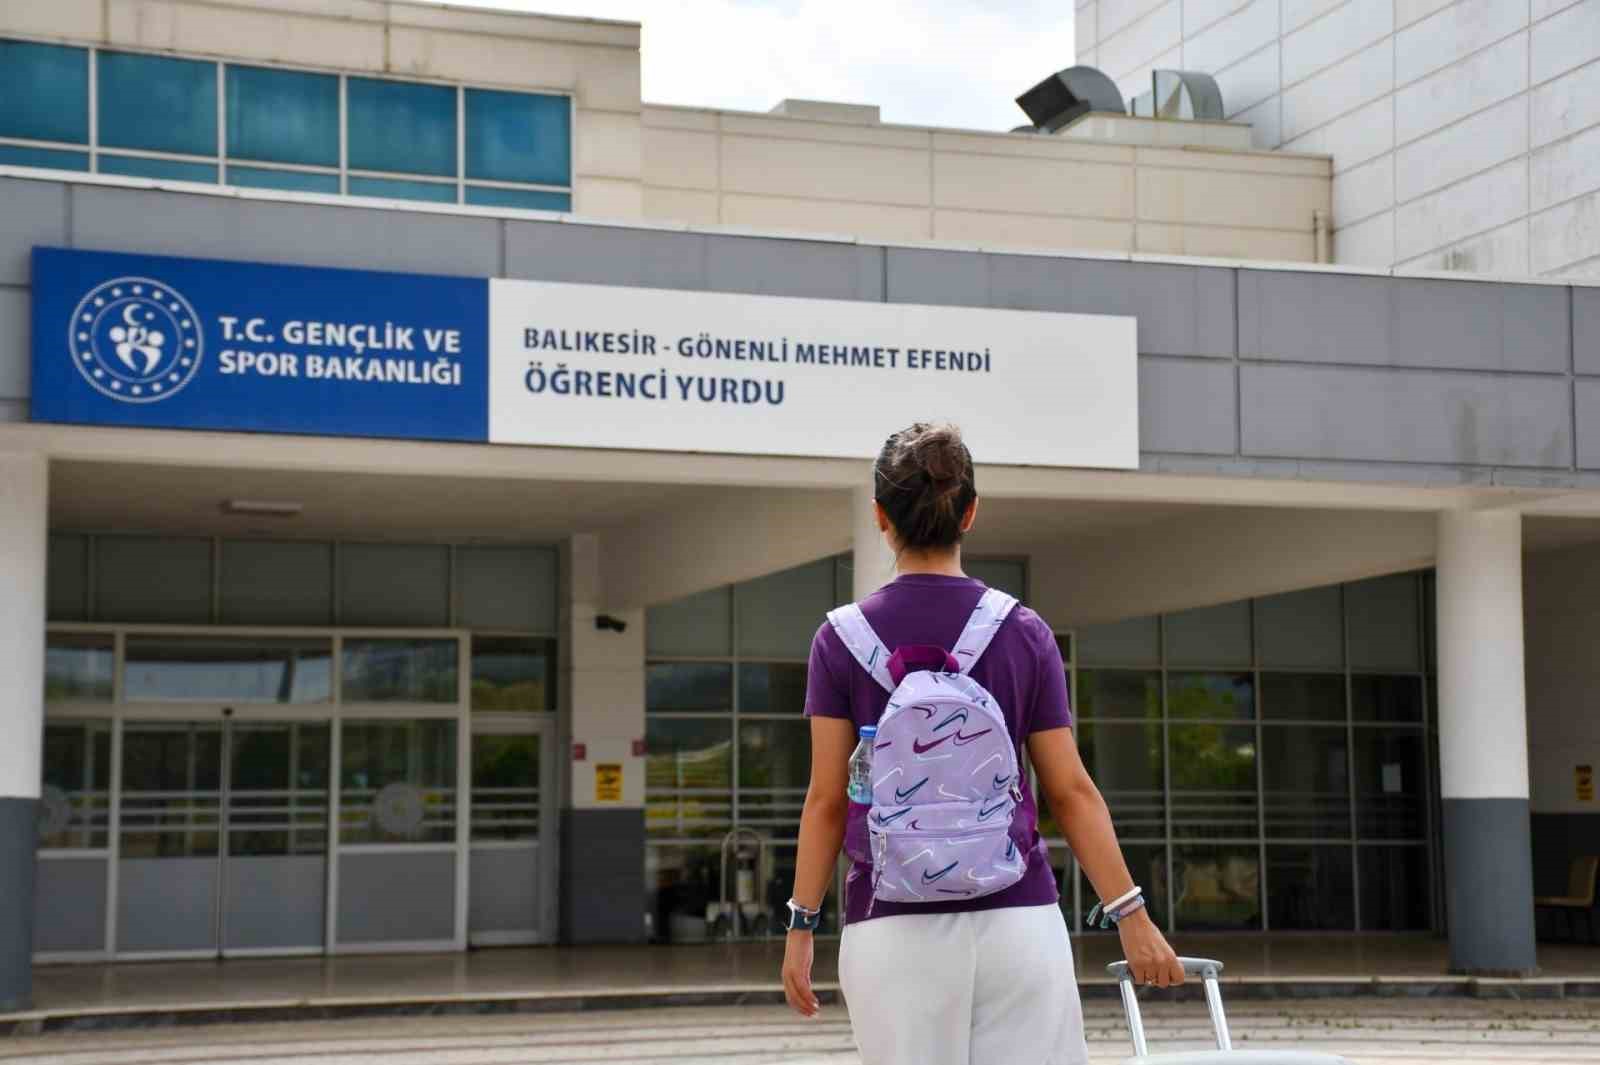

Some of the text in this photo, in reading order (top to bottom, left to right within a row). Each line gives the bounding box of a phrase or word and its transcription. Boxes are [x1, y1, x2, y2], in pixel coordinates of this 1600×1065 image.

[219, 317, 461, 354] T.C. GENÇLİK VE
[524, 327, 656, 356] BALIKESİR
[678, 334, 788, 363] GÖNENLİ
[795, 344, 899, 368] MEHMET
[906, 347, 991, 373] EFENDİ
[219, 350, 461, 385] SPOR BAKANLIĞI
[524, 362, 785, 405] ÖĞRENCİ YURDU
